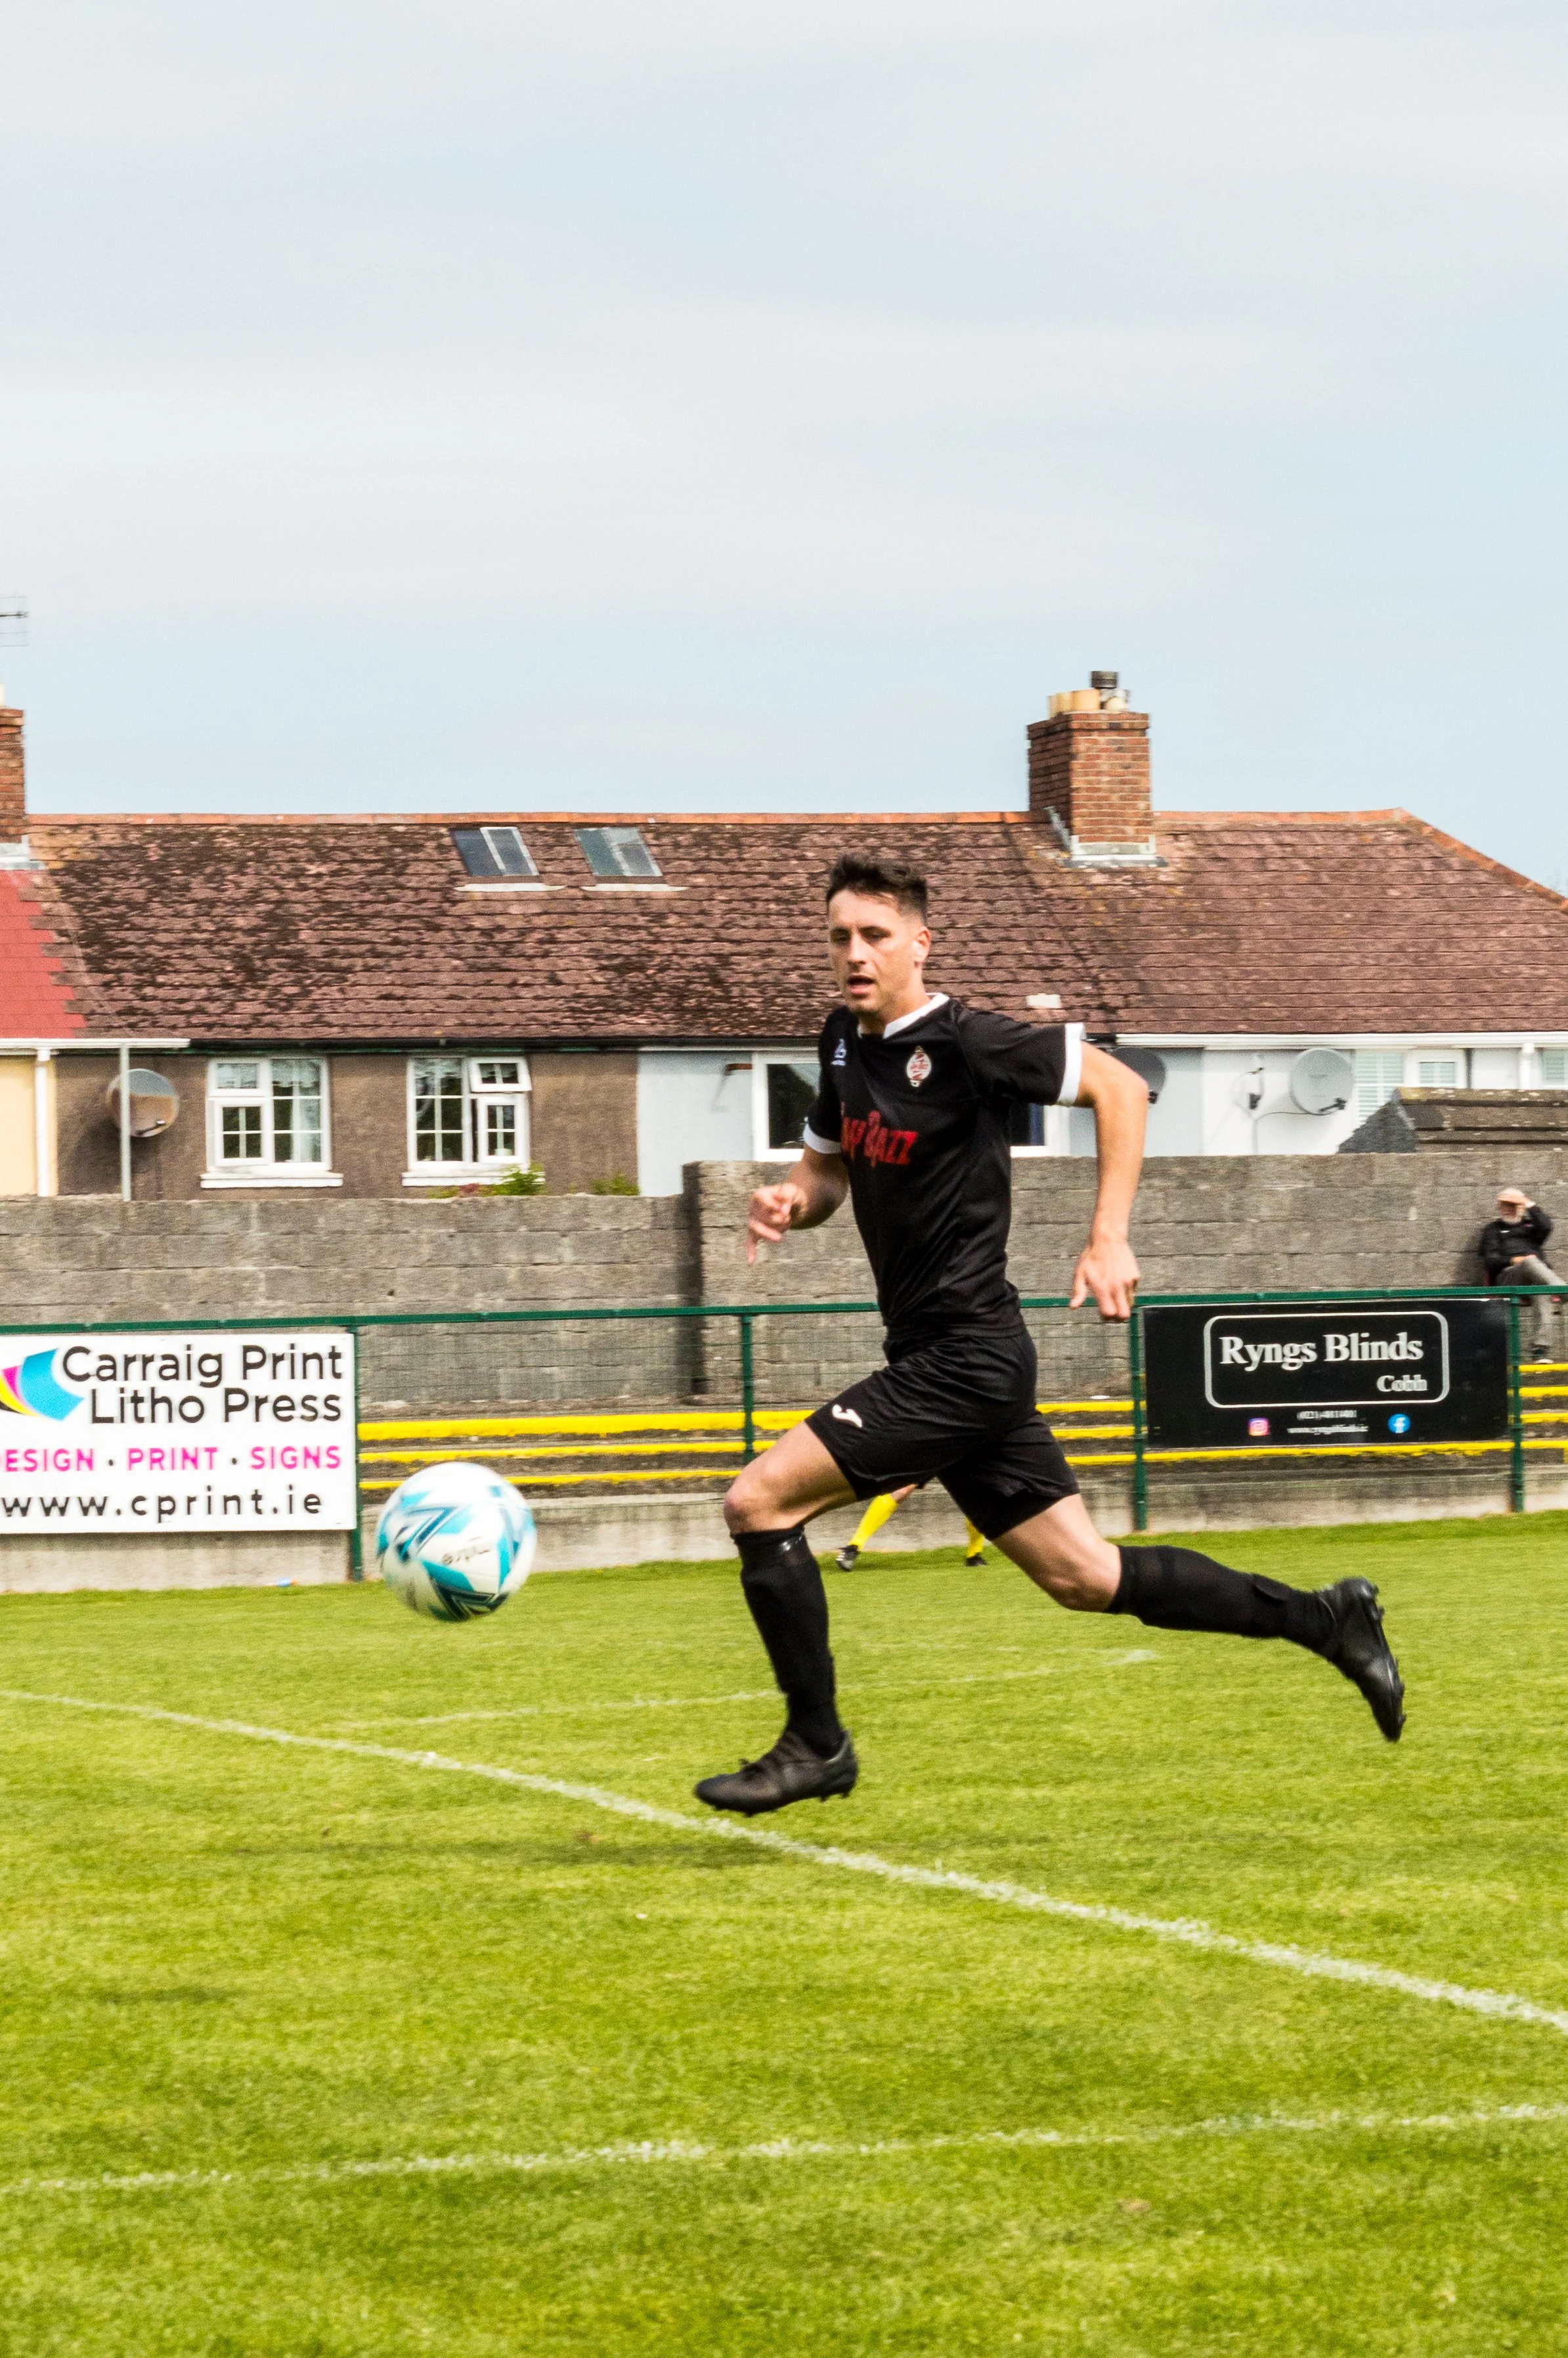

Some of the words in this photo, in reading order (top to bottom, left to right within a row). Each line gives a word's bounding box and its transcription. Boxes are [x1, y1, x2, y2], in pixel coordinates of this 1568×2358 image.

[63, 1343, 223, 1387] Carraig
[242, 1343, 342, 1380] Print
[1219, 1336, 1317, 1371] Ryngs
[1324, 1332, 1424, 1362] Blinds
[92, 1387, 205, 1424] Litho
[224, 1387, 341, 1422] Press
[0, 1448, 94, 1472] ESIGN
[127, 1447, 218, 1470] PRINT
[251, 1445, 341, 1470] SIGNS
[2, 1485, 322, 1523] www.cprint.ie
